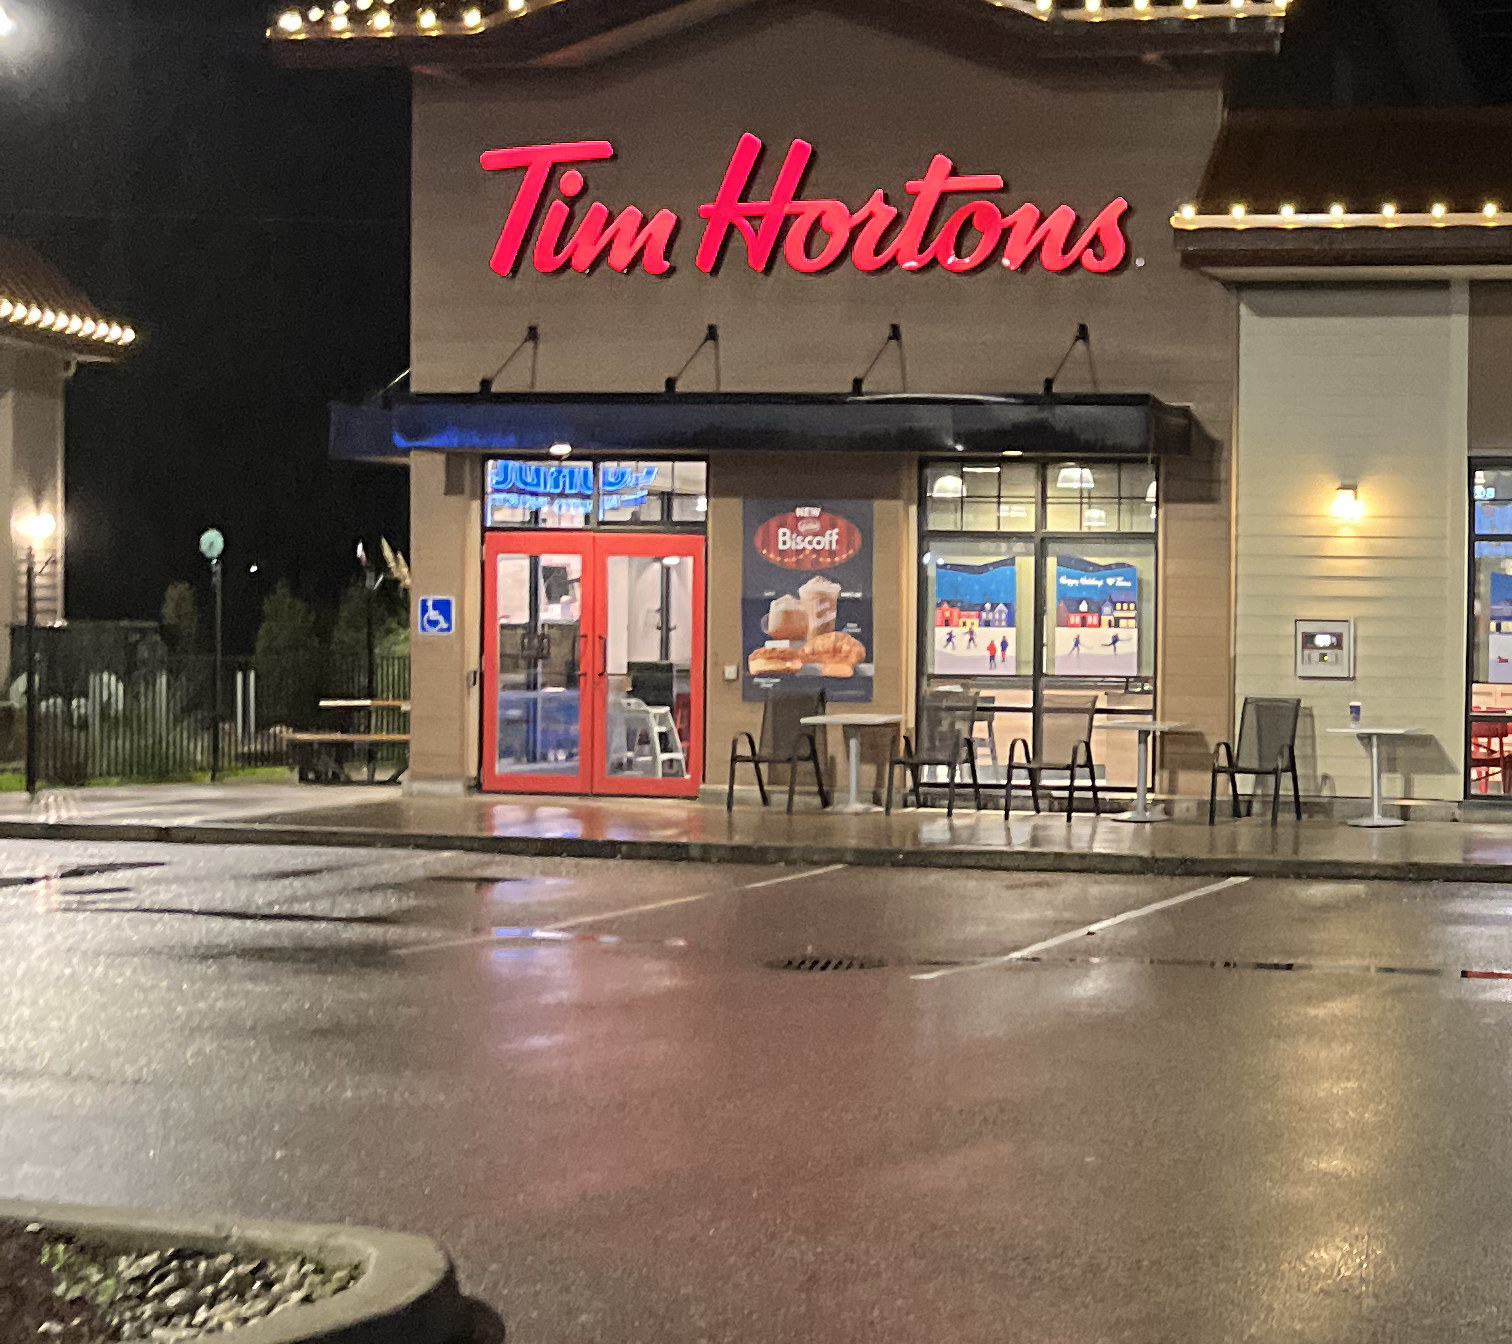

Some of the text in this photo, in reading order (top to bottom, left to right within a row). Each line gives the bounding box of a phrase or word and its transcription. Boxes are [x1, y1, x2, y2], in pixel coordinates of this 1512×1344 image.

[479, 131, 1129, 277] Tim Hortons
[778, 527, 840, 551] Biscoff
